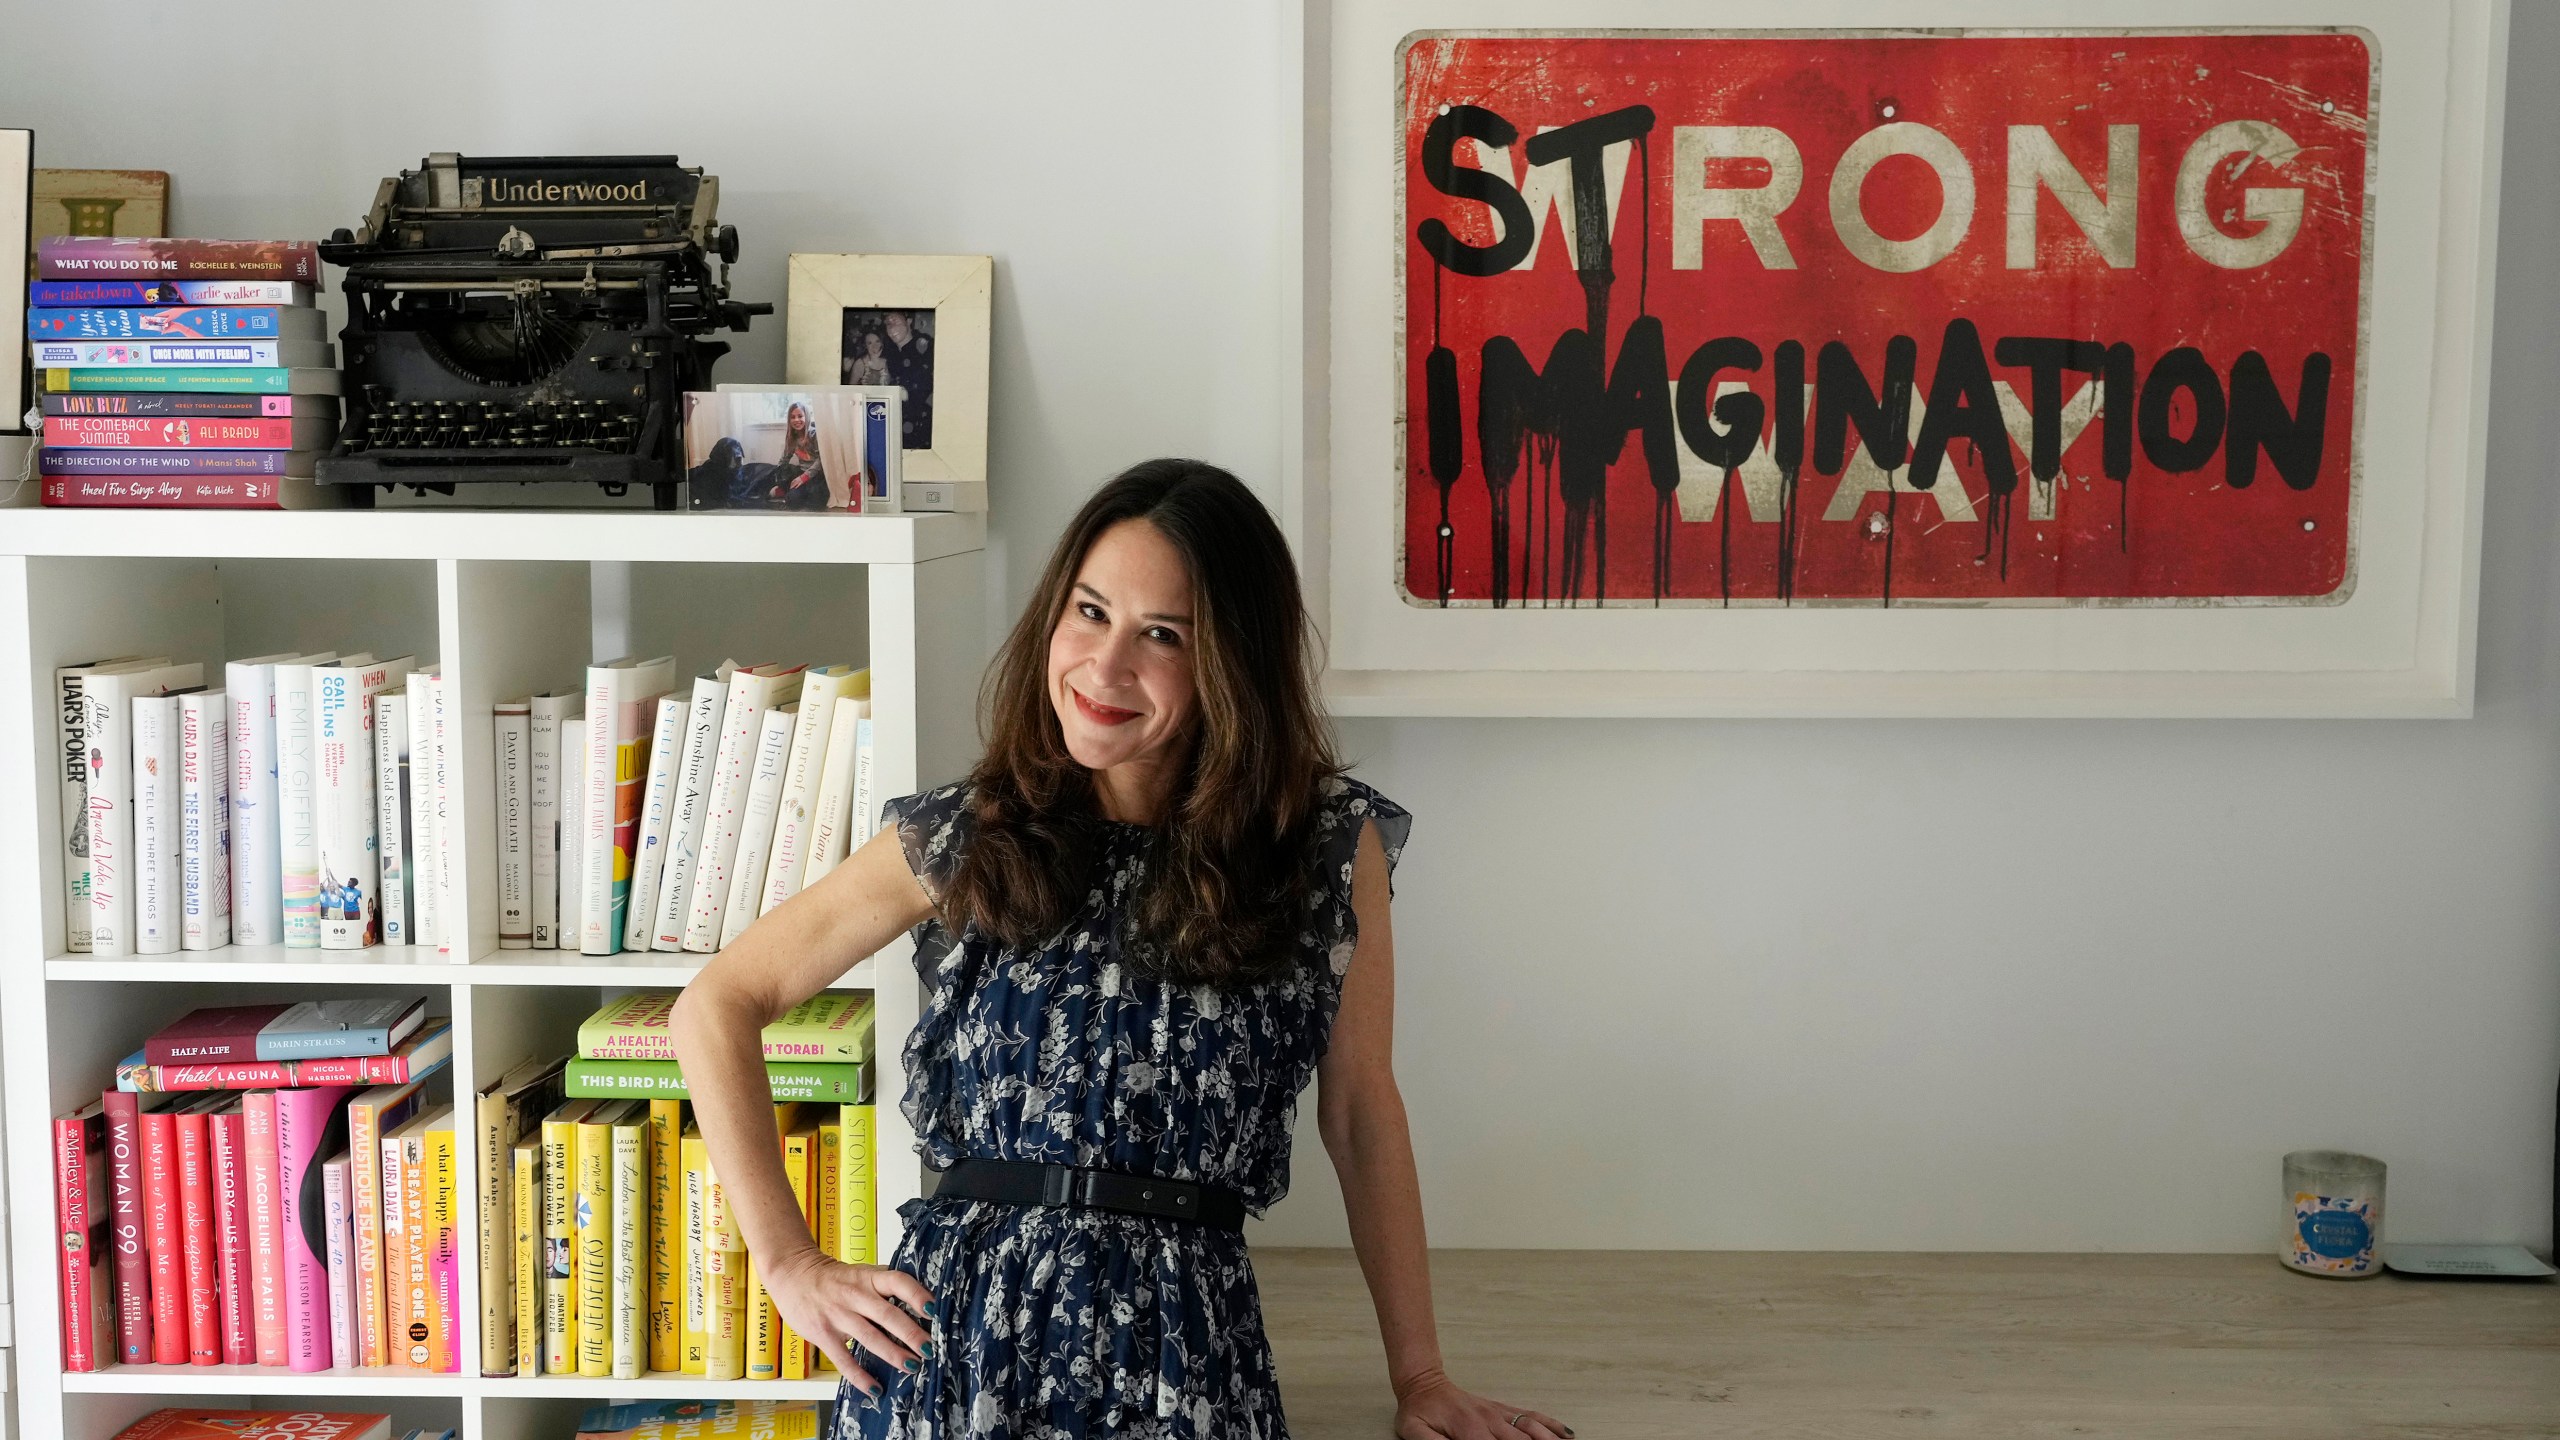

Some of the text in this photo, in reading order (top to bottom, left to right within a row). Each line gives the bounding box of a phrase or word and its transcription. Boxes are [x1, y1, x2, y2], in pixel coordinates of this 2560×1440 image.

[490, 178, 647, 201] Underwood
[1417, 104, 2306, 276] STRONG
[55, 259, 178, 270] WHAT YOU DO TO ME
[60, 286, 133, 301] takedown
[190, 286, 261, 301] carlie walker
[153, 349, 250, 360] ONCE MORE WITH FEELING
[62, 397, 128, 413] LOVE BUZZ
[1427, 317, 2330, 492] IMAGINATION
[58, 418, 150, 432] THE COMEBACK
[80, 432, 130, 445] SUMMER
[200, 426, 260, 439] ALI BRADY
[45, 457, 190, 467] THE DIRECTION OF THE WIND
[206, 458, 257, 467] Mansi Shah
[81, 482, 183, 499] Hazel Fine Sings Along
[214, 485, 235, 496] Wicks
[333, 677, 345, 710] GAIL
[362, 670, 386, 688] WHEN
[236, 701, 250, 743] Emily
[323, 677, 334, 737] COLLINS
[62, 675, 87, 783] LIAR'S POKER
[507, 731, 518, 770] DAVID
[680, 697, 712, 823] My Sunshine Away
[760, 730, 784, 781] blink
[795, 703, 820, 792] baby proof
[289, 691, 311, 848] EMILY GIFFIN
[380, 704, 393, 852] Happiness Sold Separately
[184, 709, 199, 915] LAURA DAVE THE FIRST HUSBAND
[509, 797, 520, 853] GOLIATH
[779, 824, 796, 872] emily
[814, 824, 833, 863] Diary
[669, 885, 682, 920] WALSH
[171, 1046, 230, 1057] HALF A LIFE
[268, 1037, 346, 1049] DARIN STRAUSS
[592, 1048, 651, 1058] STATE OF
[606, 1036, 616, 1047] A
[775, 1043, 824, 1055] TORABI
[173, 1066, 280, 1083] Hotel LAGUNA
[307, 1074, 352, 1082] HARRISON
[313, 1065, 345, 1073] NICOLA
[580, 1075, 687, 1089] THIS BIRD HAS
[770, 1076, 823, 1086] USANNA
[773, 1087, 813, 1098] HOFFS
[435, 1144, 451, 1173] what
[65, 1137, 83, 1224] Marley & Me
[113, 1123, 138, 1255] WOMAN 99
[222, 1145, 236, 1208] HISTORY
[546, 1143, 554, 1226] TO A WIDOWER
[555, 1143, 565, 1225] HOW TO TALK
[825, 1165, 836, 1211] ROSIE
[848, 1117, 868, 1263] STONE COLD
[354, 1123, 376, 1272] MUSTIQUE ISLAND
[435, 1186, 451, 1226] happy
[225, 1210, 233, 1222] OF
[226, 1226, 238, 1244] US
[255, 1165, 275, 1321] JACQUELINE PARIS
[407, 1168, 425, 1320] READY PLAYER ONE
[436, 1226, 454, 1265] family
[184, 1201, 210, 1328] ask again later
[438, 1271, 450, 1314] saumya
[440, 1312, 453, 1341] dave
[758, 1301, 767, 1353] STEWART
